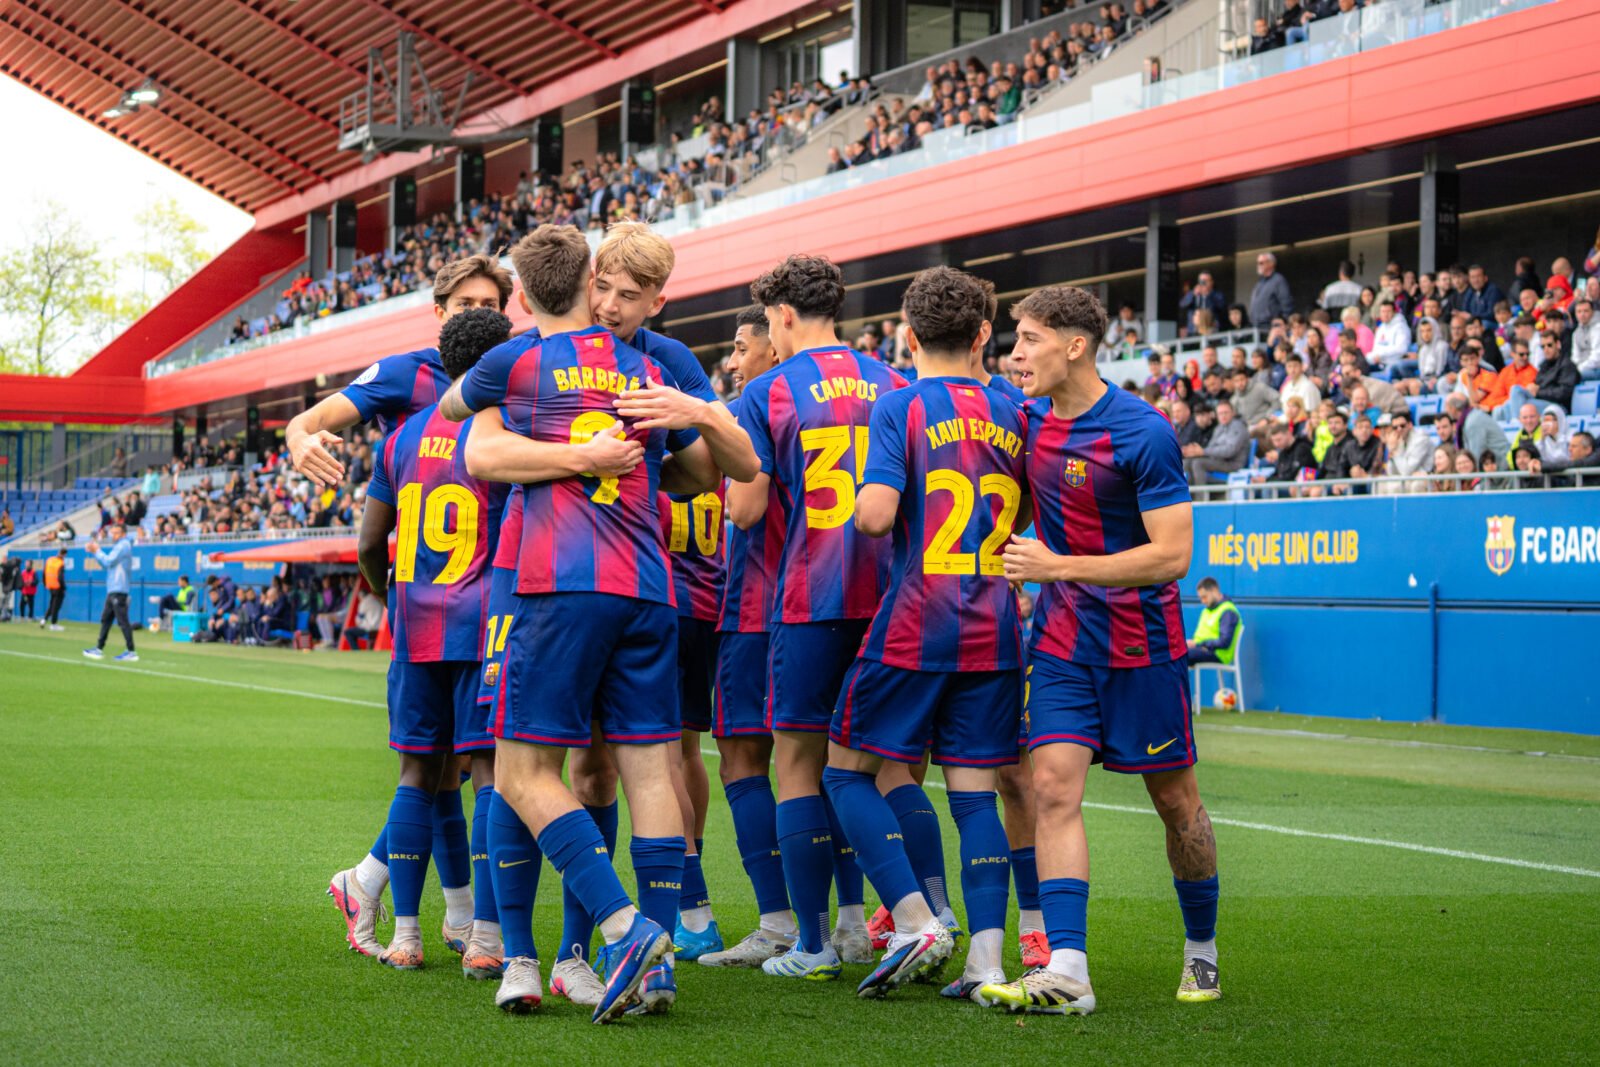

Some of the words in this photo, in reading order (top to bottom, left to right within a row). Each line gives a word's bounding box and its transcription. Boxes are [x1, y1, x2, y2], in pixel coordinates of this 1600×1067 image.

[809, 376, 878, 403] CAMPOS
[418, 436, 457, 460] AZIZ
[925, 417, 966, 450] XAVI
[968, 418, 1023, 458] ESPART
[395, 482, 479, 584] 19
[669, 491, 722, 556] 10
[923, 468, 1021, 576] 22
[1208, 524, 1244, 565] MÉS
[1246, 533, 1281, 571] QUE
[1284, 532, 1309, 564] UN
[1312, 530, 1359, 563] CLUB
[1521, 526, 1548, 564] FC
